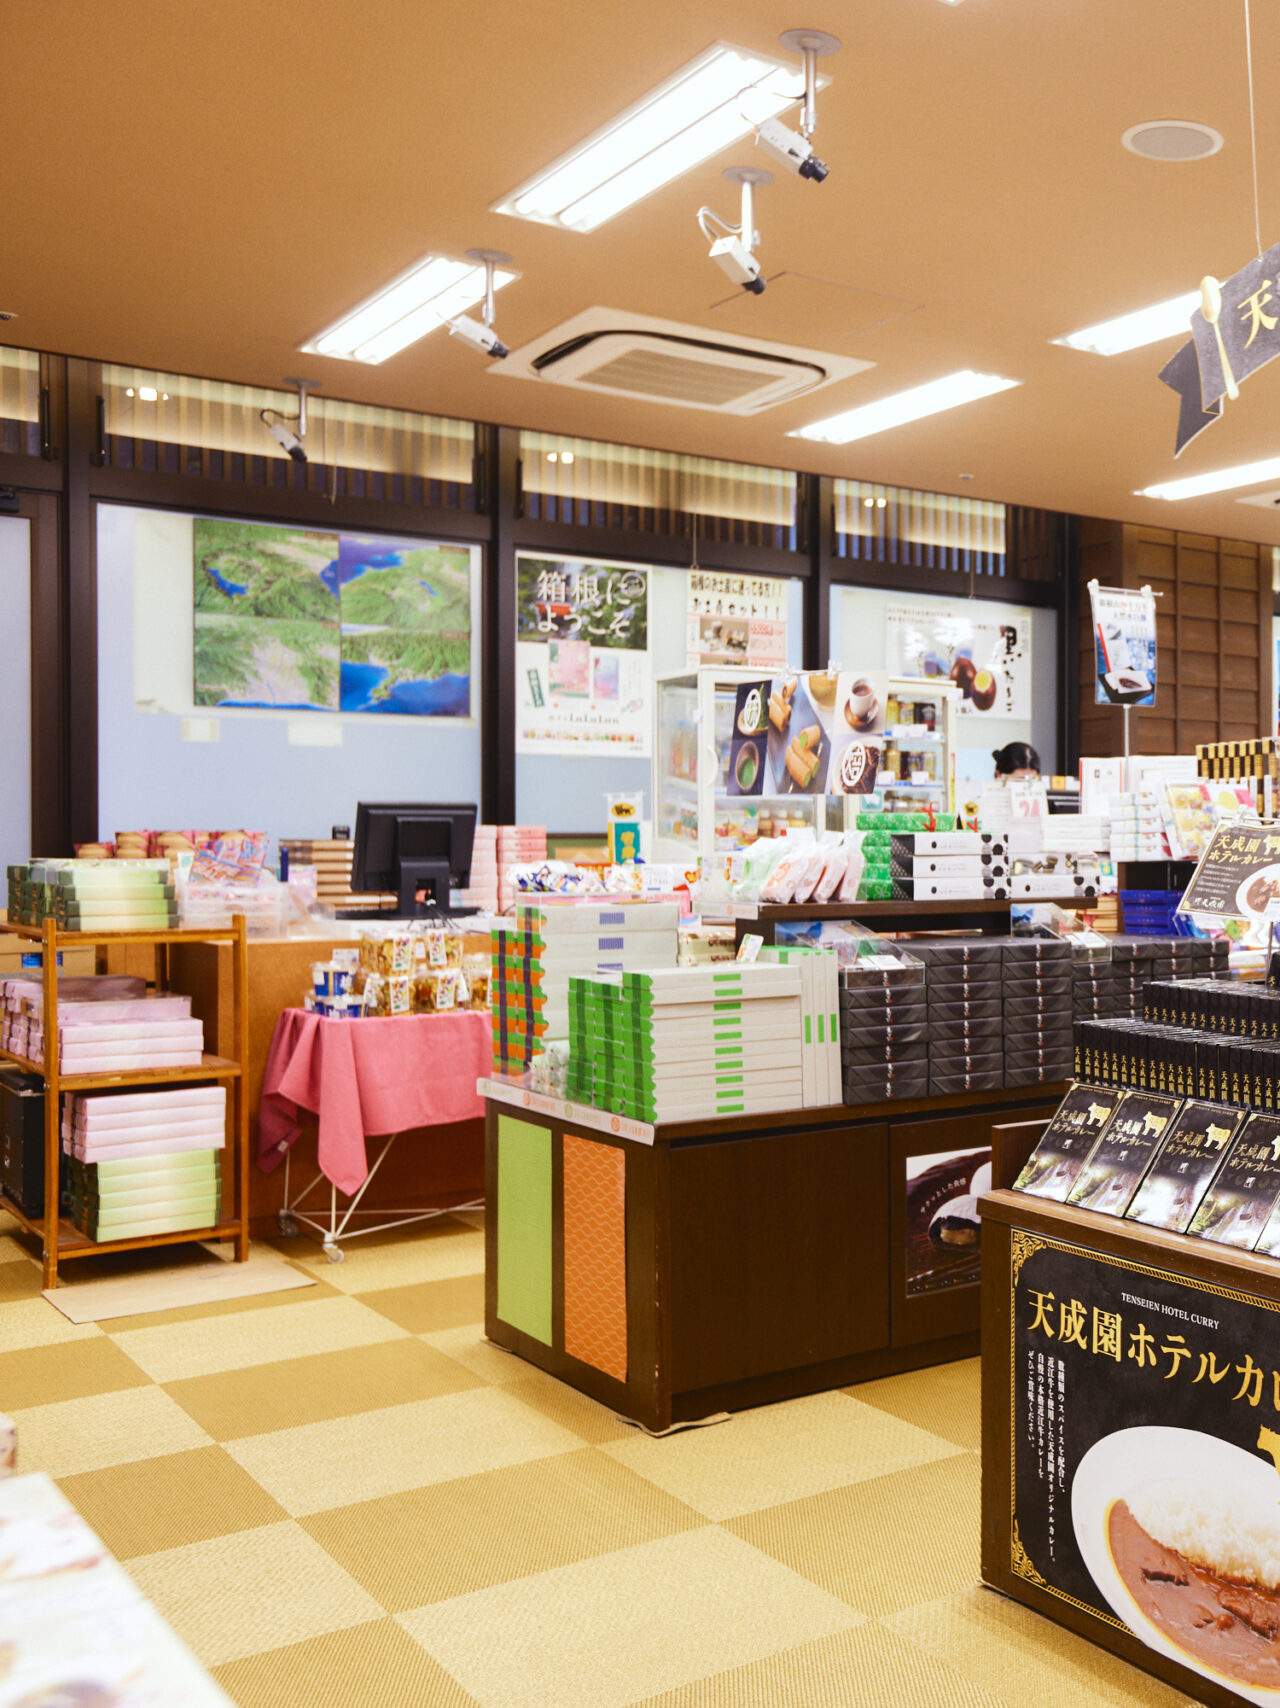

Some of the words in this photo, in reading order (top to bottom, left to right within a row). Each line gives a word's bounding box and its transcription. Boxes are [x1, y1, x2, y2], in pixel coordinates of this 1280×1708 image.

[537, 569, 632, 605] 箱根に
[536, 608, 631, 638] ようこそ
[1214, 835, 1263, 854] 天成園
[1208, 849, 1275, 865] ホテルカレー
[1057, 1110, 1088, 1126] 天成園
[1113, 1119, 1143, 1135] 天成園
[1173, 1130, 1204, 1147] 天成園
[1234, 1143, 1272, 1161] 天成園
[1121, 1292, 1160, 1312] TENSEIEN
[1161, 1305, 1190, 1322] HOTEL
[1190, 1313, 1220, 1330] CURRY
